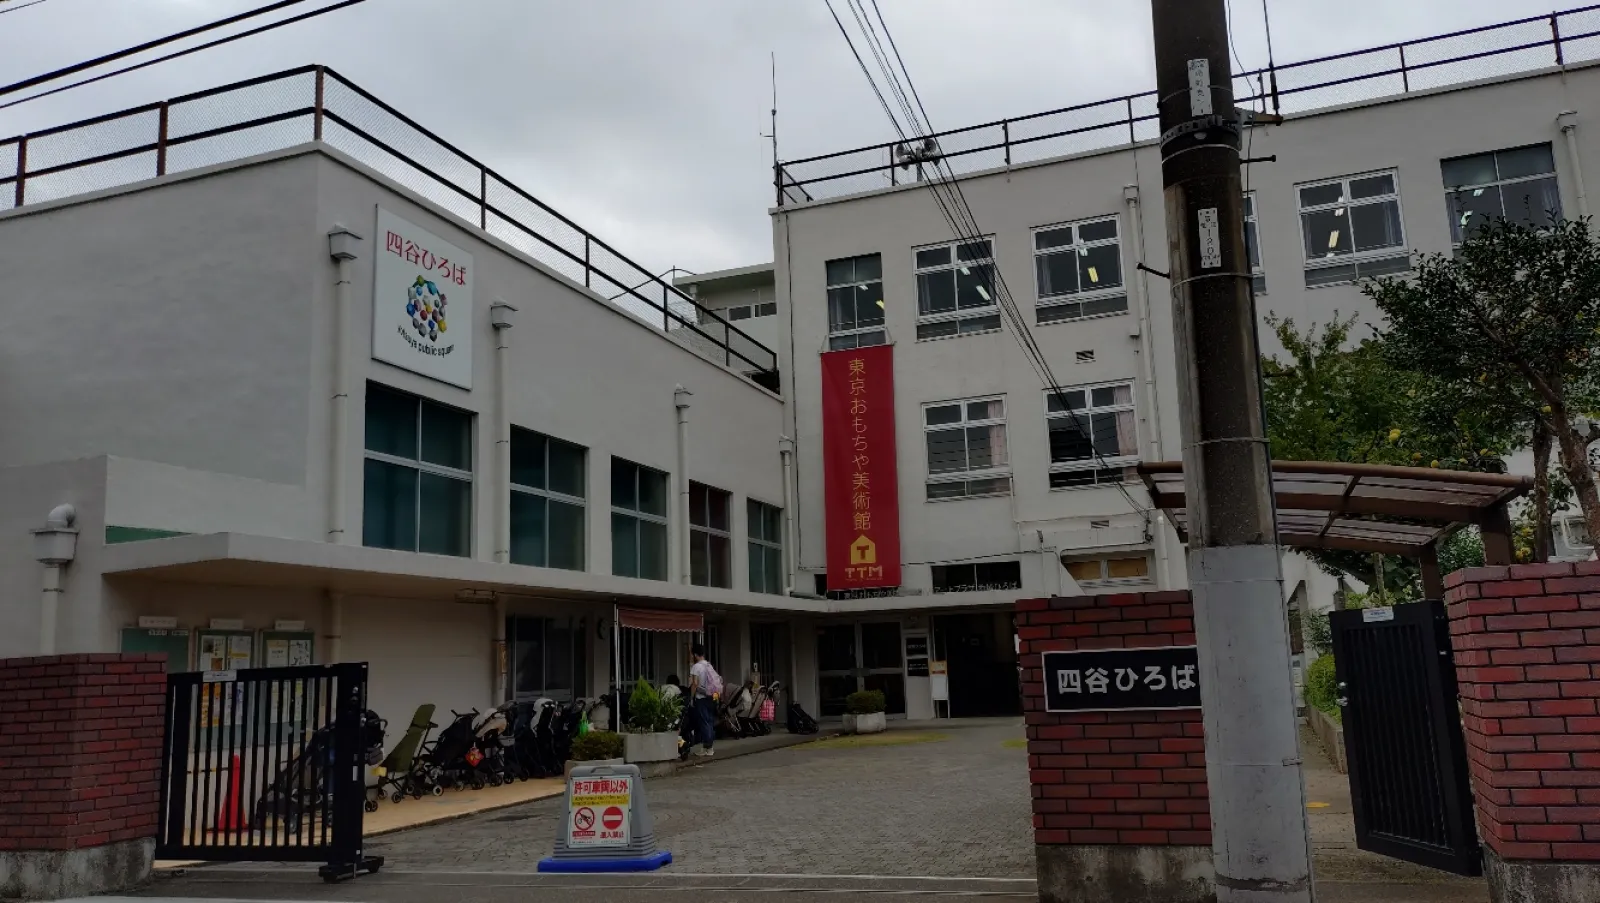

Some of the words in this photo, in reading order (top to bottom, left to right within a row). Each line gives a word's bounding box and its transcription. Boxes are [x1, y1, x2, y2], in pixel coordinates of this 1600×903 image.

[386, 230, 467, 286] 四谷ひろば
[844, 565, 883, 579] TTM
[1056, 664, 1197, 695] 四谷ひろば
[574, 779, 628, 794] 許可車両以外
